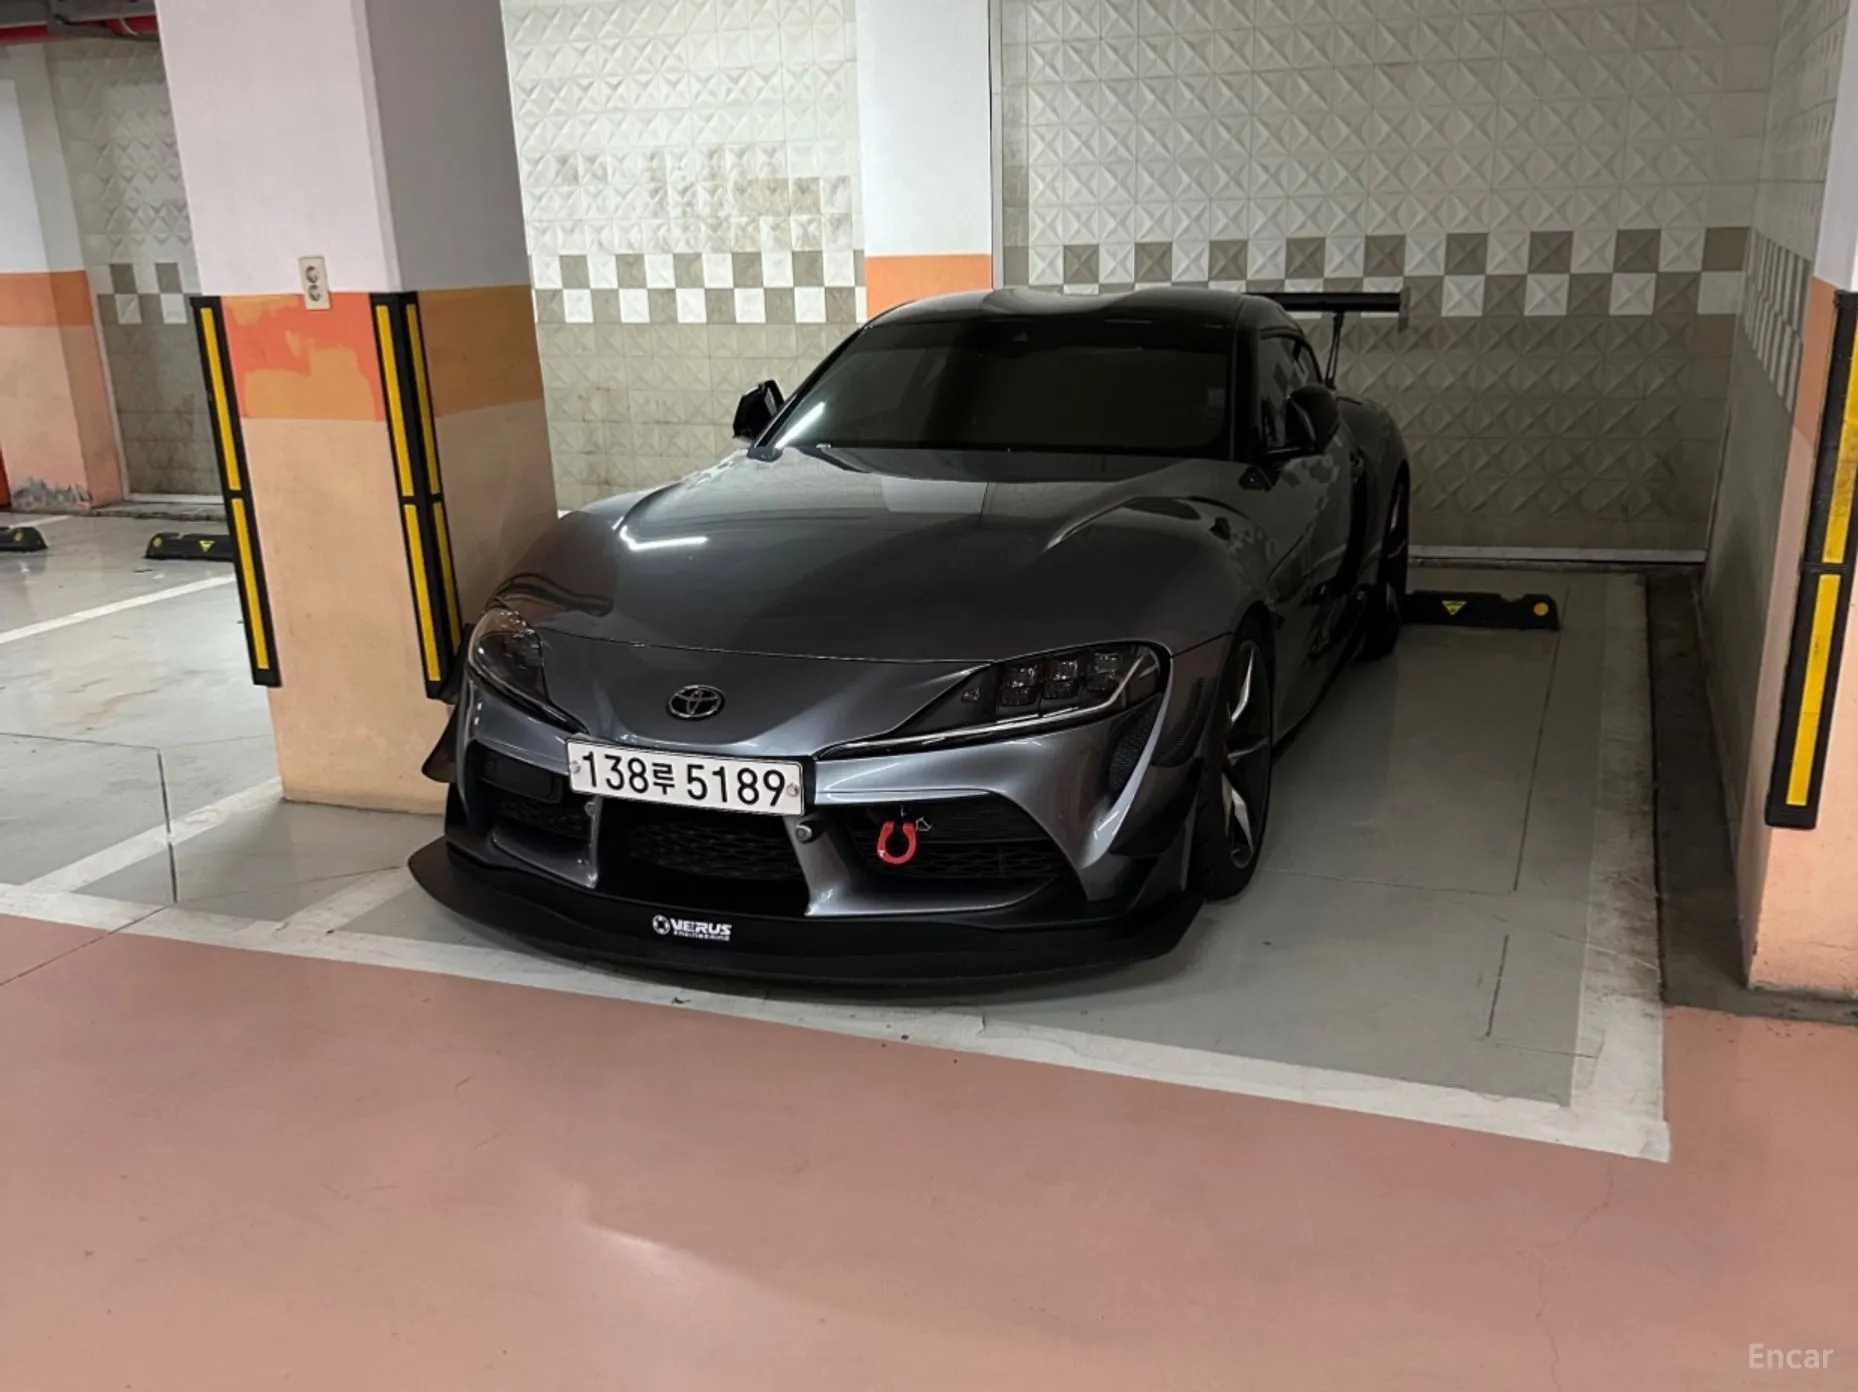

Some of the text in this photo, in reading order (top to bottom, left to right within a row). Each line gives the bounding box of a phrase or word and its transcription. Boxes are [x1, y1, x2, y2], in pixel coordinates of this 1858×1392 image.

[582, 751, 785, 807] 138루 5189
[670, 918, 732, 935] VERUS
